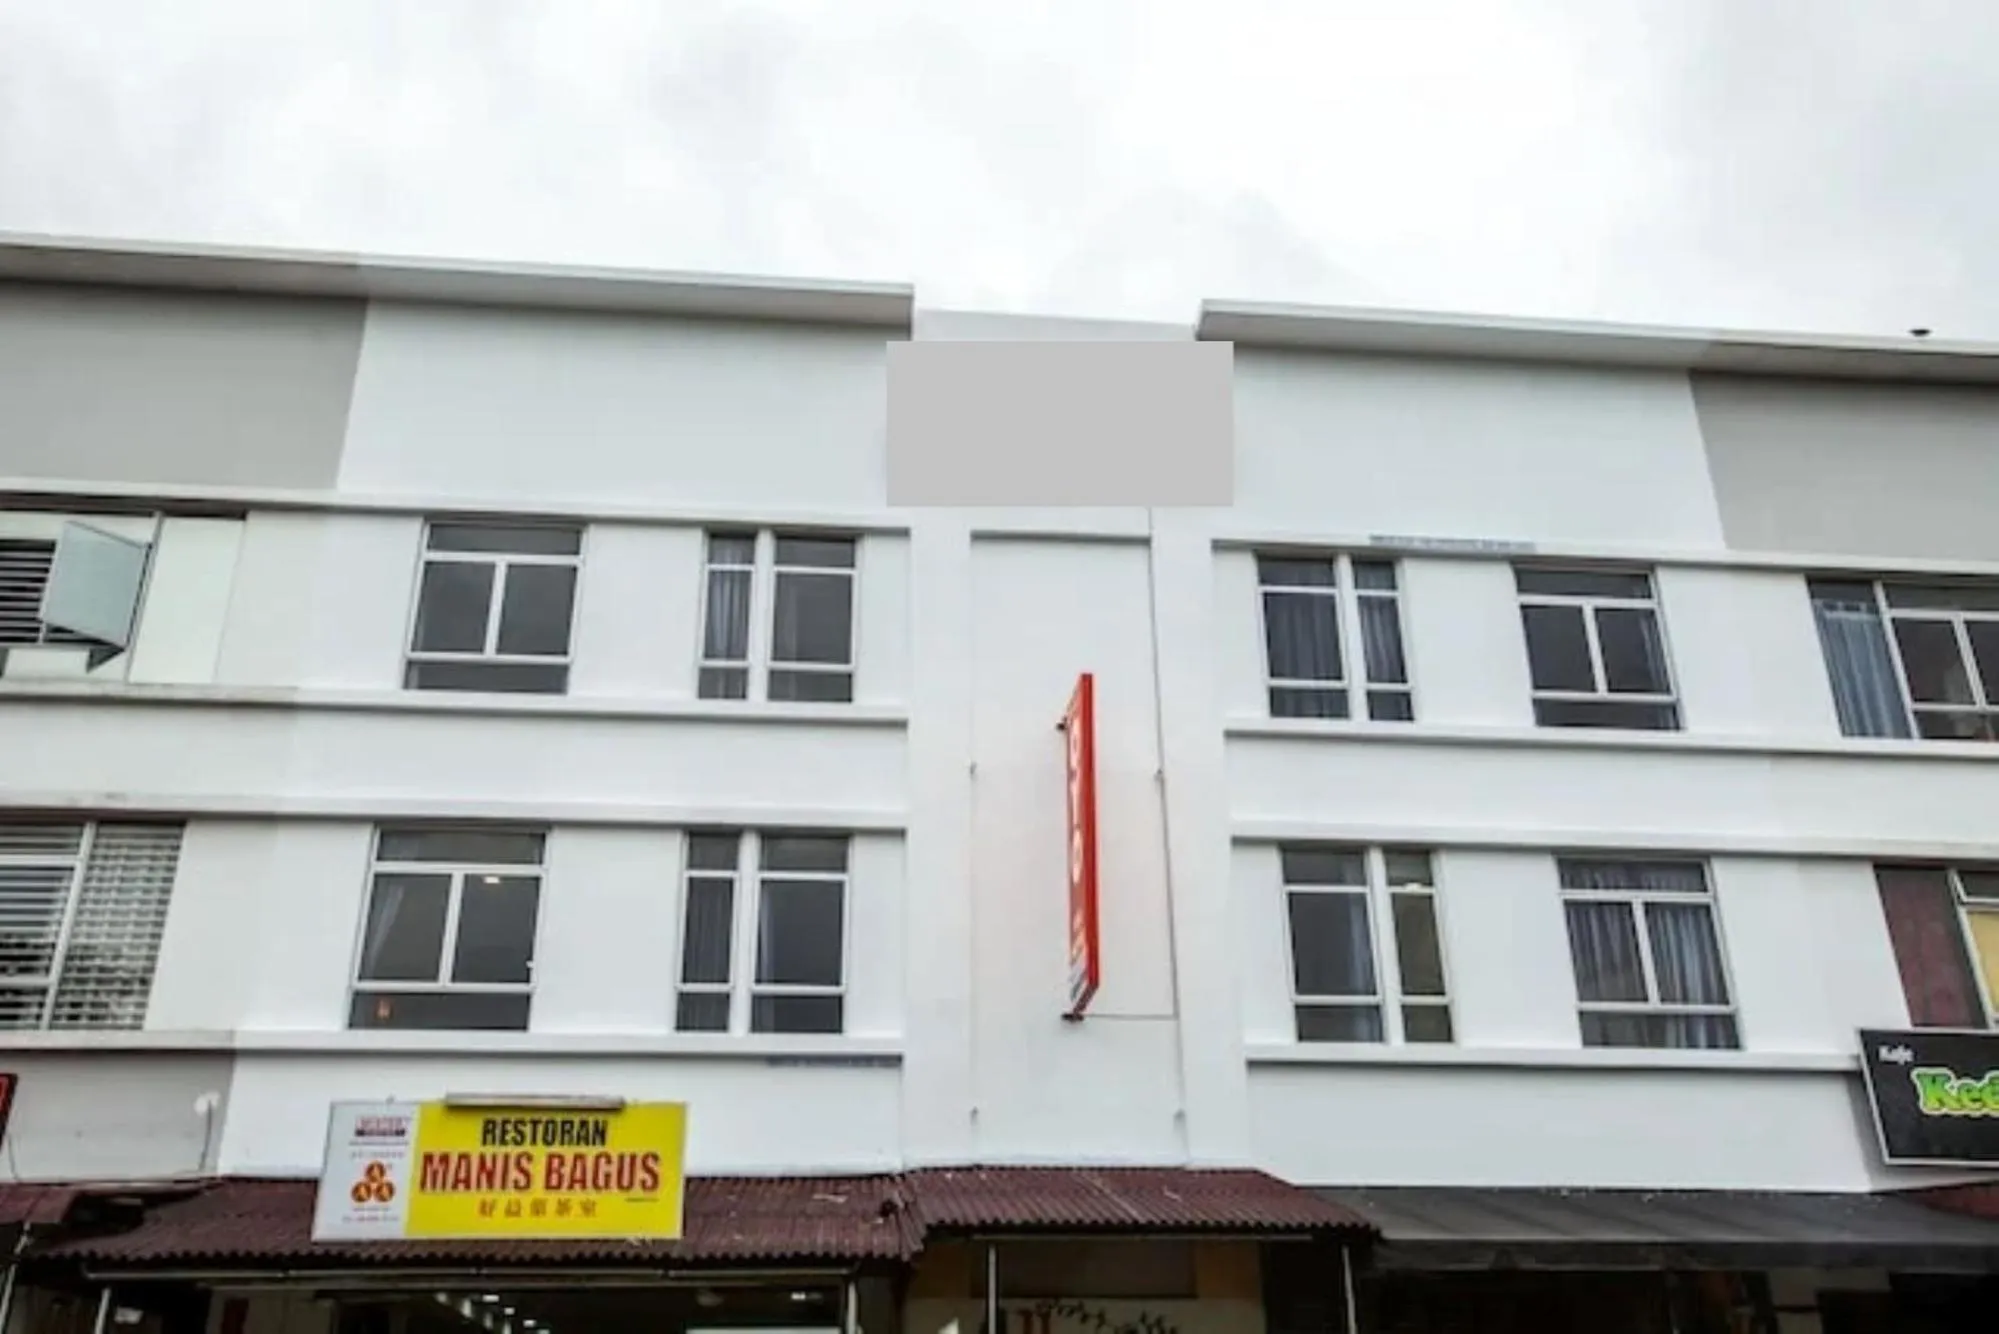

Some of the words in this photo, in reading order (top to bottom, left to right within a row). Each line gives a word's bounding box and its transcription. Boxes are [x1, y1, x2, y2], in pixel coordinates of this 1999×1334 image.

[481, 1118, 608, 1147] RESTORAN
[419, 1151, 534, 1193] MANIS
[543, 1151, 661, 1193] BAGUS
